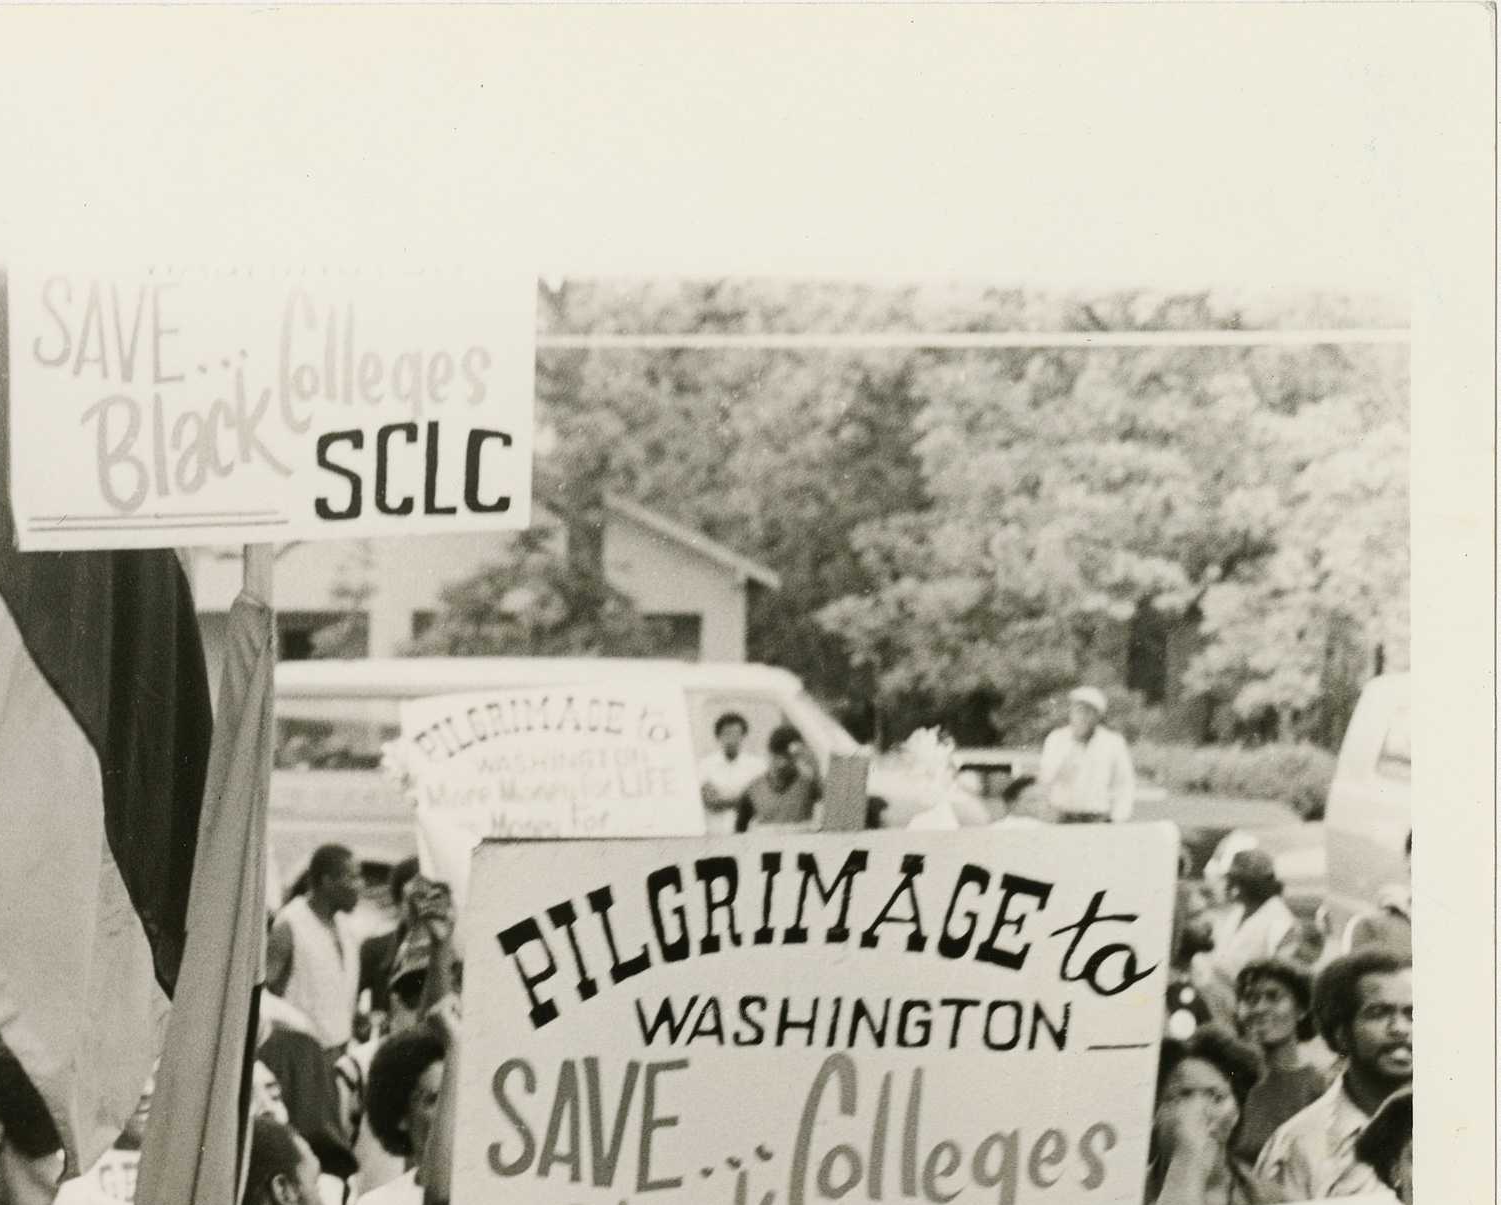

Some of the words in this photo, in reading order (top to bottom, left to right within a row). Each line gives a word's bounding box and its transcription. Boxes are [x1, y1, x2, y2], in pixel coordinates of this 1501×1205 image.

[279, 286, 492, 434] Colleges
[80, 364, 293, 514] Black
[314, 420, 513, 522] SCLC
[413, 695, 625, 758] PILGRIMAGE
[496, 849, 1055, 1030] PILGRIMAGE
[1050, 889, 1160, 996] to
[635, 995, 1071, 1051] WASHINGTON
